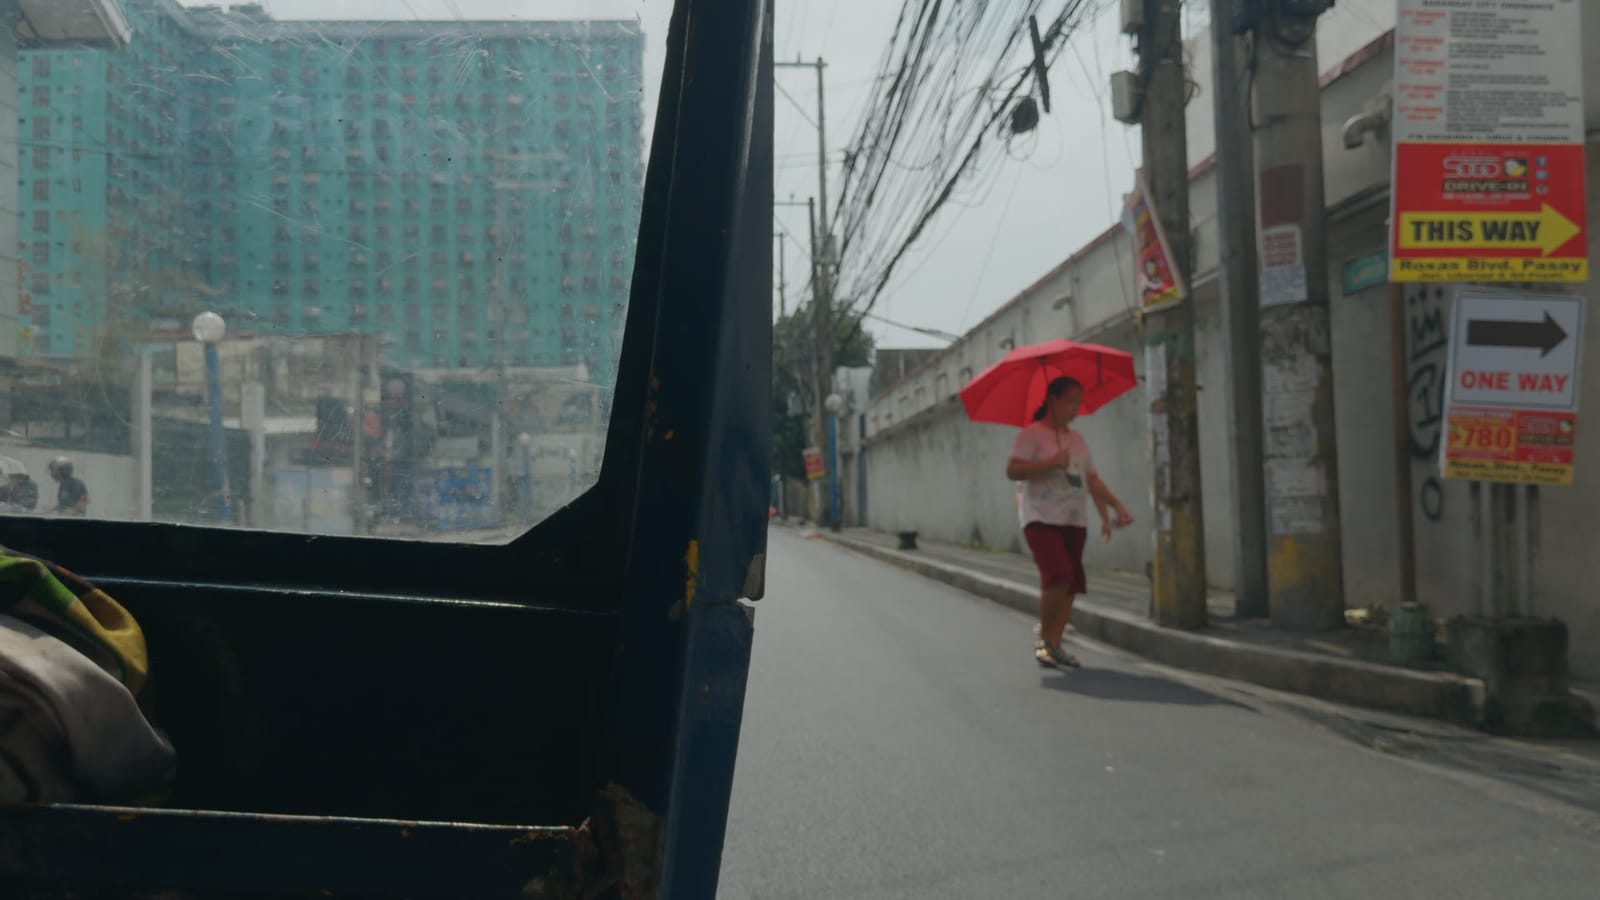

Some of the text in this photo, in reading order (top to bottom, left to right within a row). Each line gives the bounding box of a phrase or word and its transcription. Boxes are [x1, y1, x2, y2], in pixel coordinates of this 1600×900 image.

[1410, 220, 1541, 242] THIS WAY
[1400, 259, 1459, 271] Roxas
[1522, 259, 1582, 273] Pasay
[1460, 370, 1568, 394] ONE WAY
